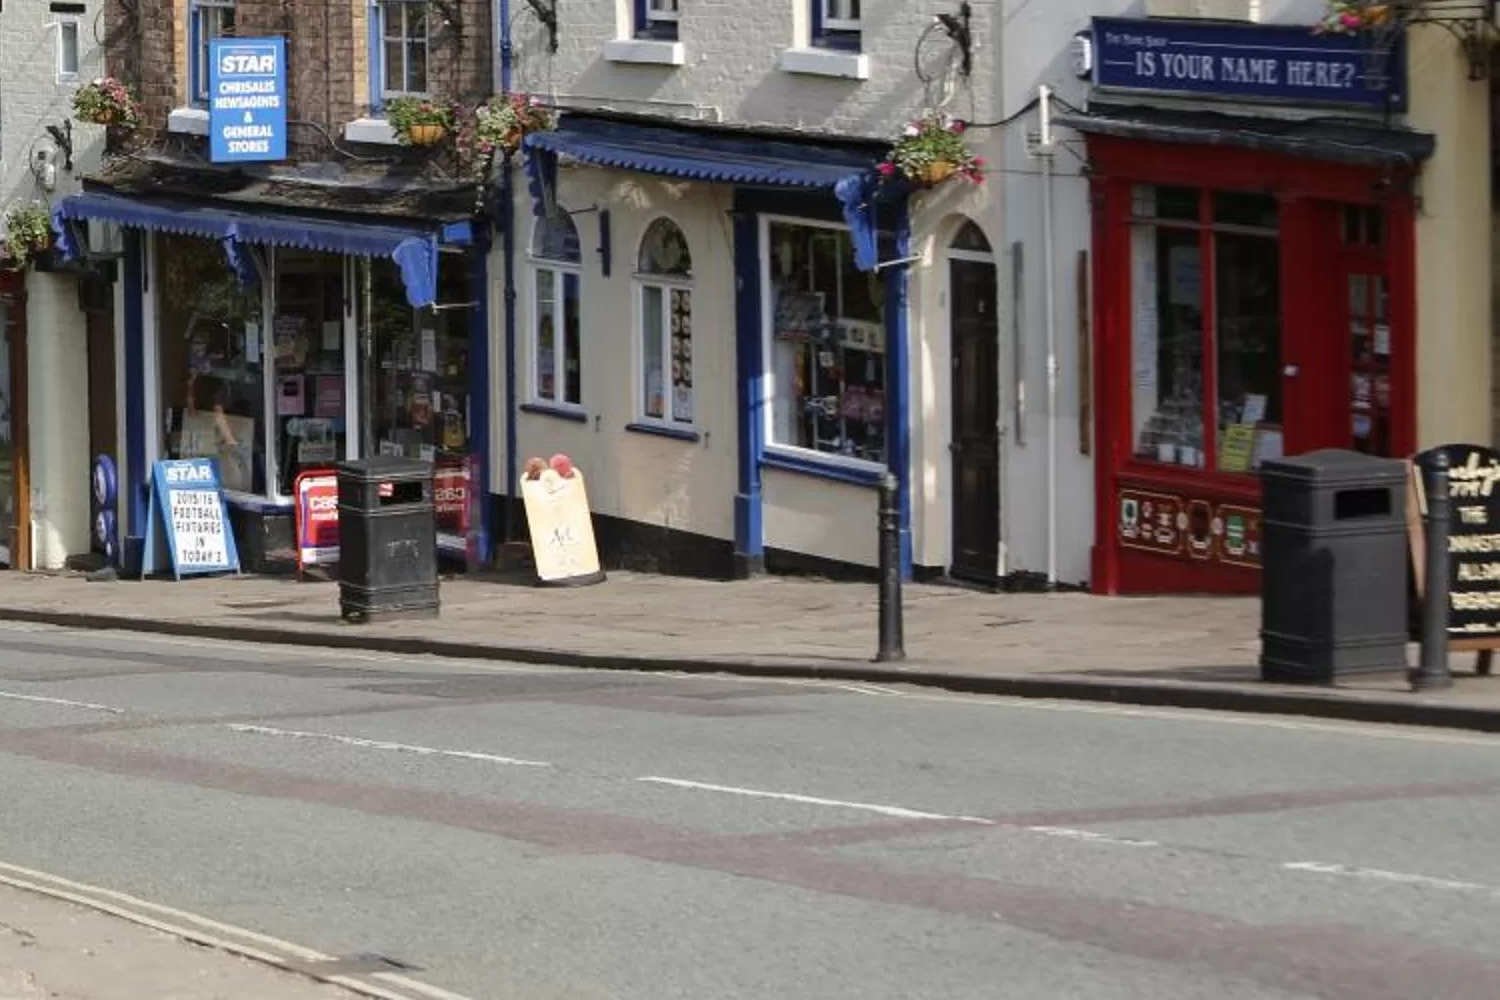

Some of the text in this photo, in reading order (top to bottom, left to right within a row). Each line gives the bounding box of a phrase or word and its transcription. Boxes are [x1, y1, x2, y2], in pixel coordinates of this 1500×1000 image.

[221, 55, 274, 73] STAR
[1135, 52, 1356, 88] IS YOUR NAME HERE?
[214, 95, 280, 109] NEWSAGENTS
[243, 111, 253, 123] &
[223, 123, 274, 139] GENERAL
[227, 139, 270, 153] STORES
[167, 465, 212, 481] STAR
[173, 507, 220, 519] FOOTBALL
